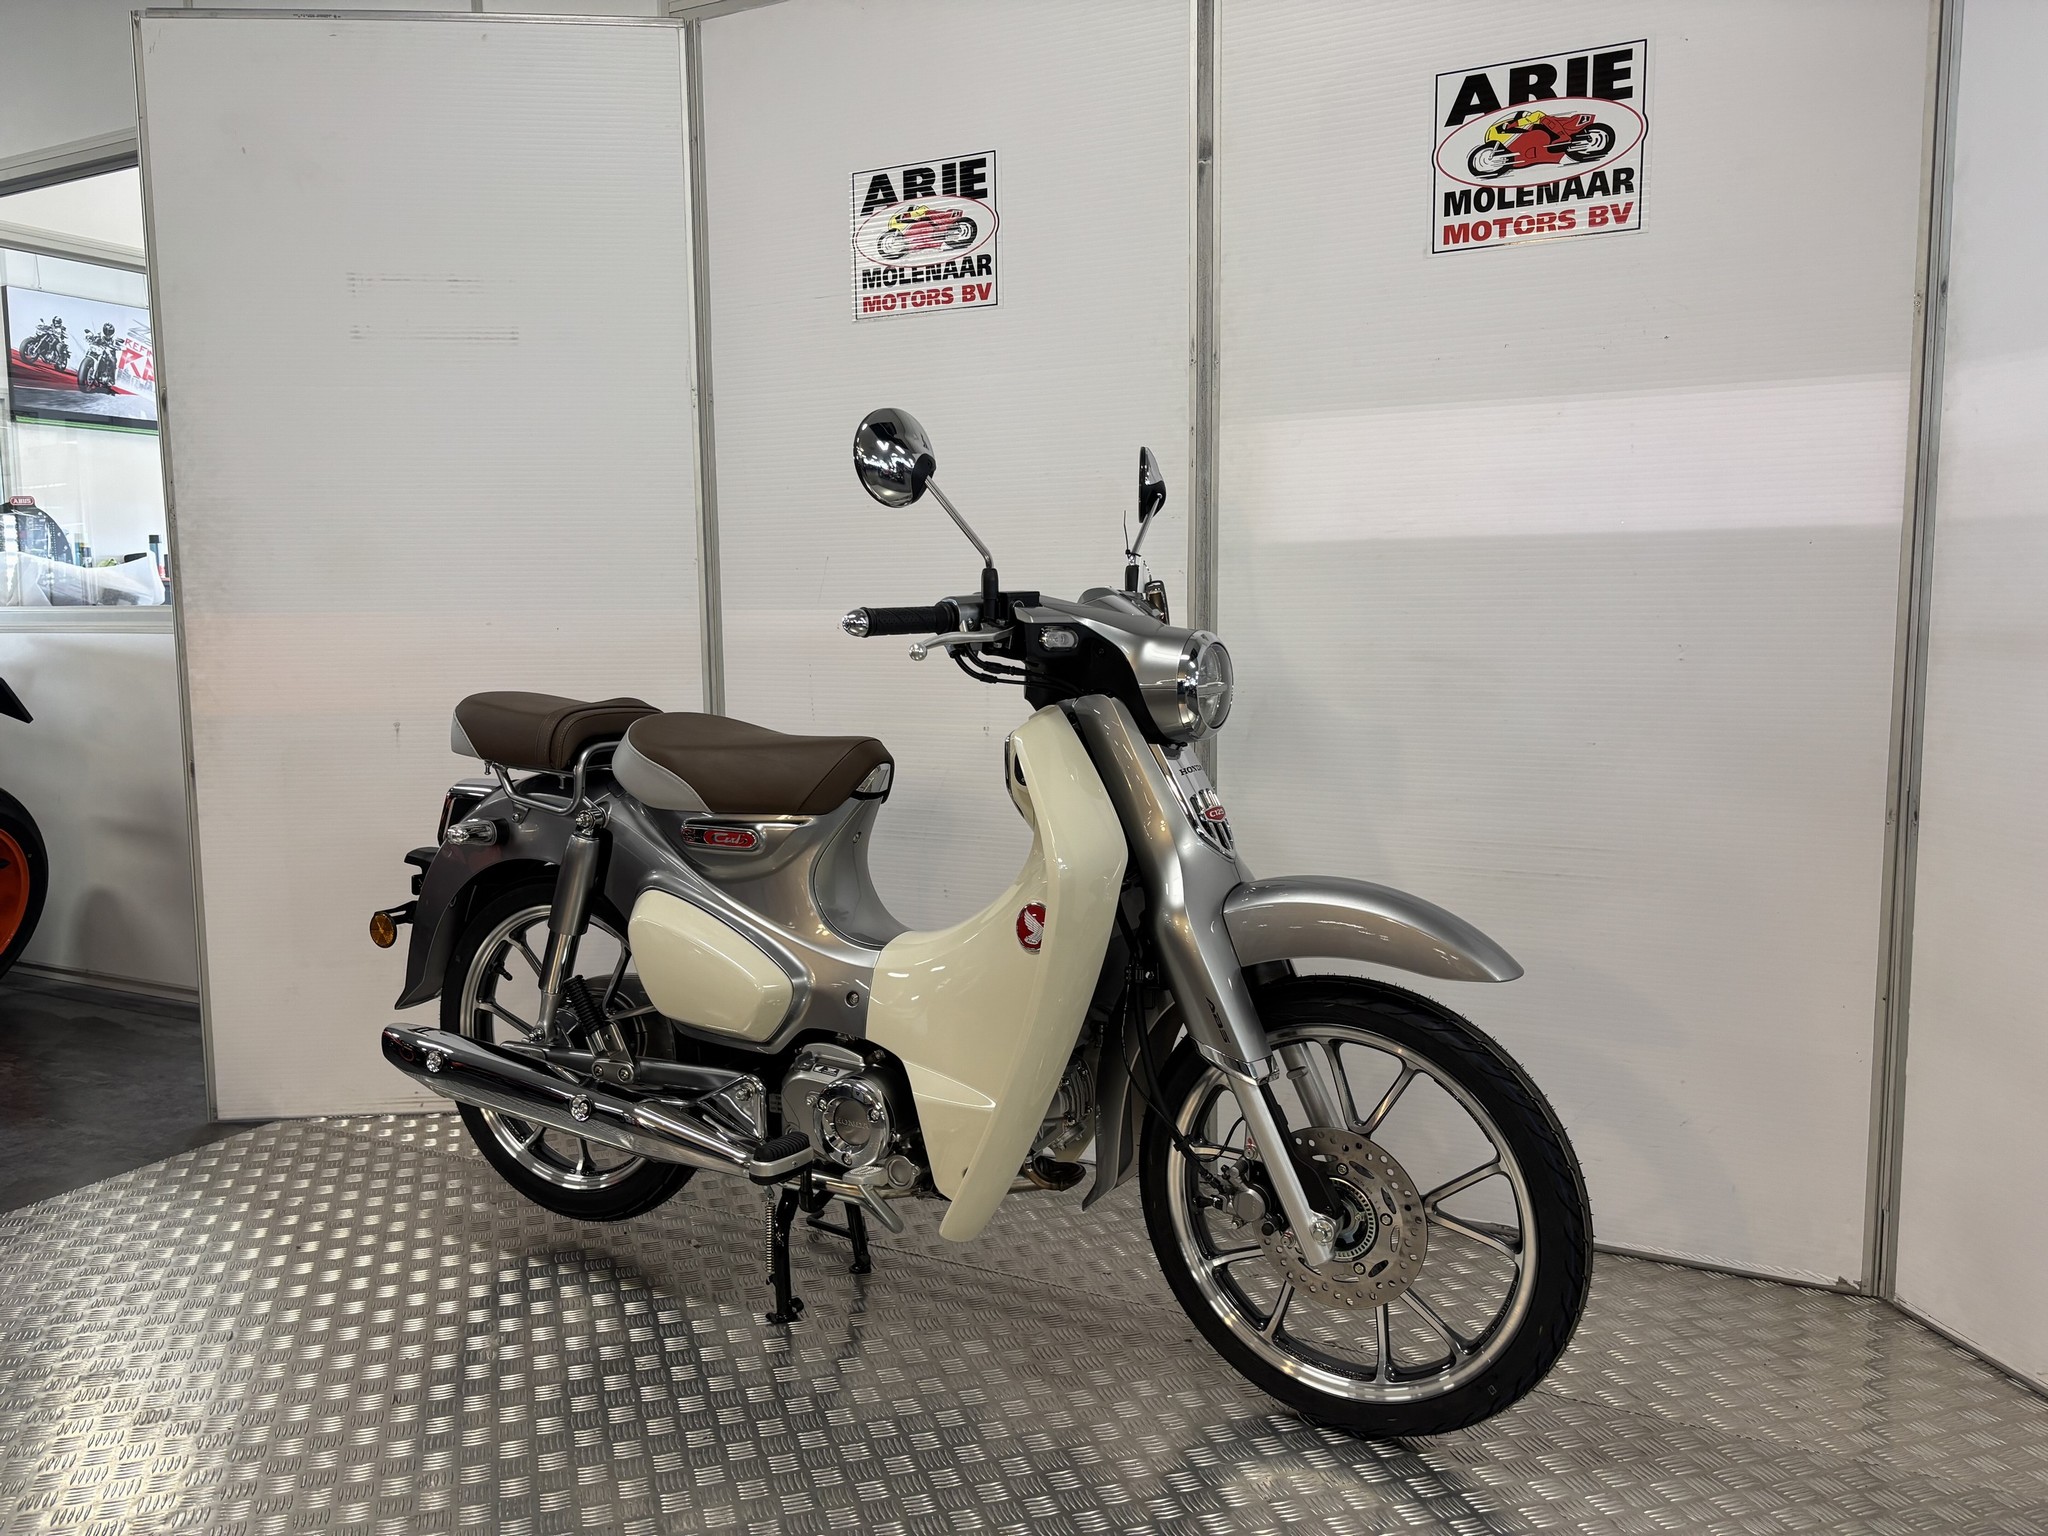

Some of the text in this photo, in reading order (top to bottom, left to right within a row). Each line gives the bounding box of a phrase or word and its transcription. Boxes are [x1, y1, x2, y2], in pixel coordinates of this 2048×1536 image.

[1444, 48, 1634, 128] ARIE
[860, 157, 988, 217] ARIE
[1443, 167, 1635, 218] MOLENAAR
[1442, 201, 1635, 246] MOTORS BV
[861, 253, 993, 290] MOLENAAR
[862, 282, 993, 313] MOTORS BV
[1179, 764, 1202, 776] HOND
